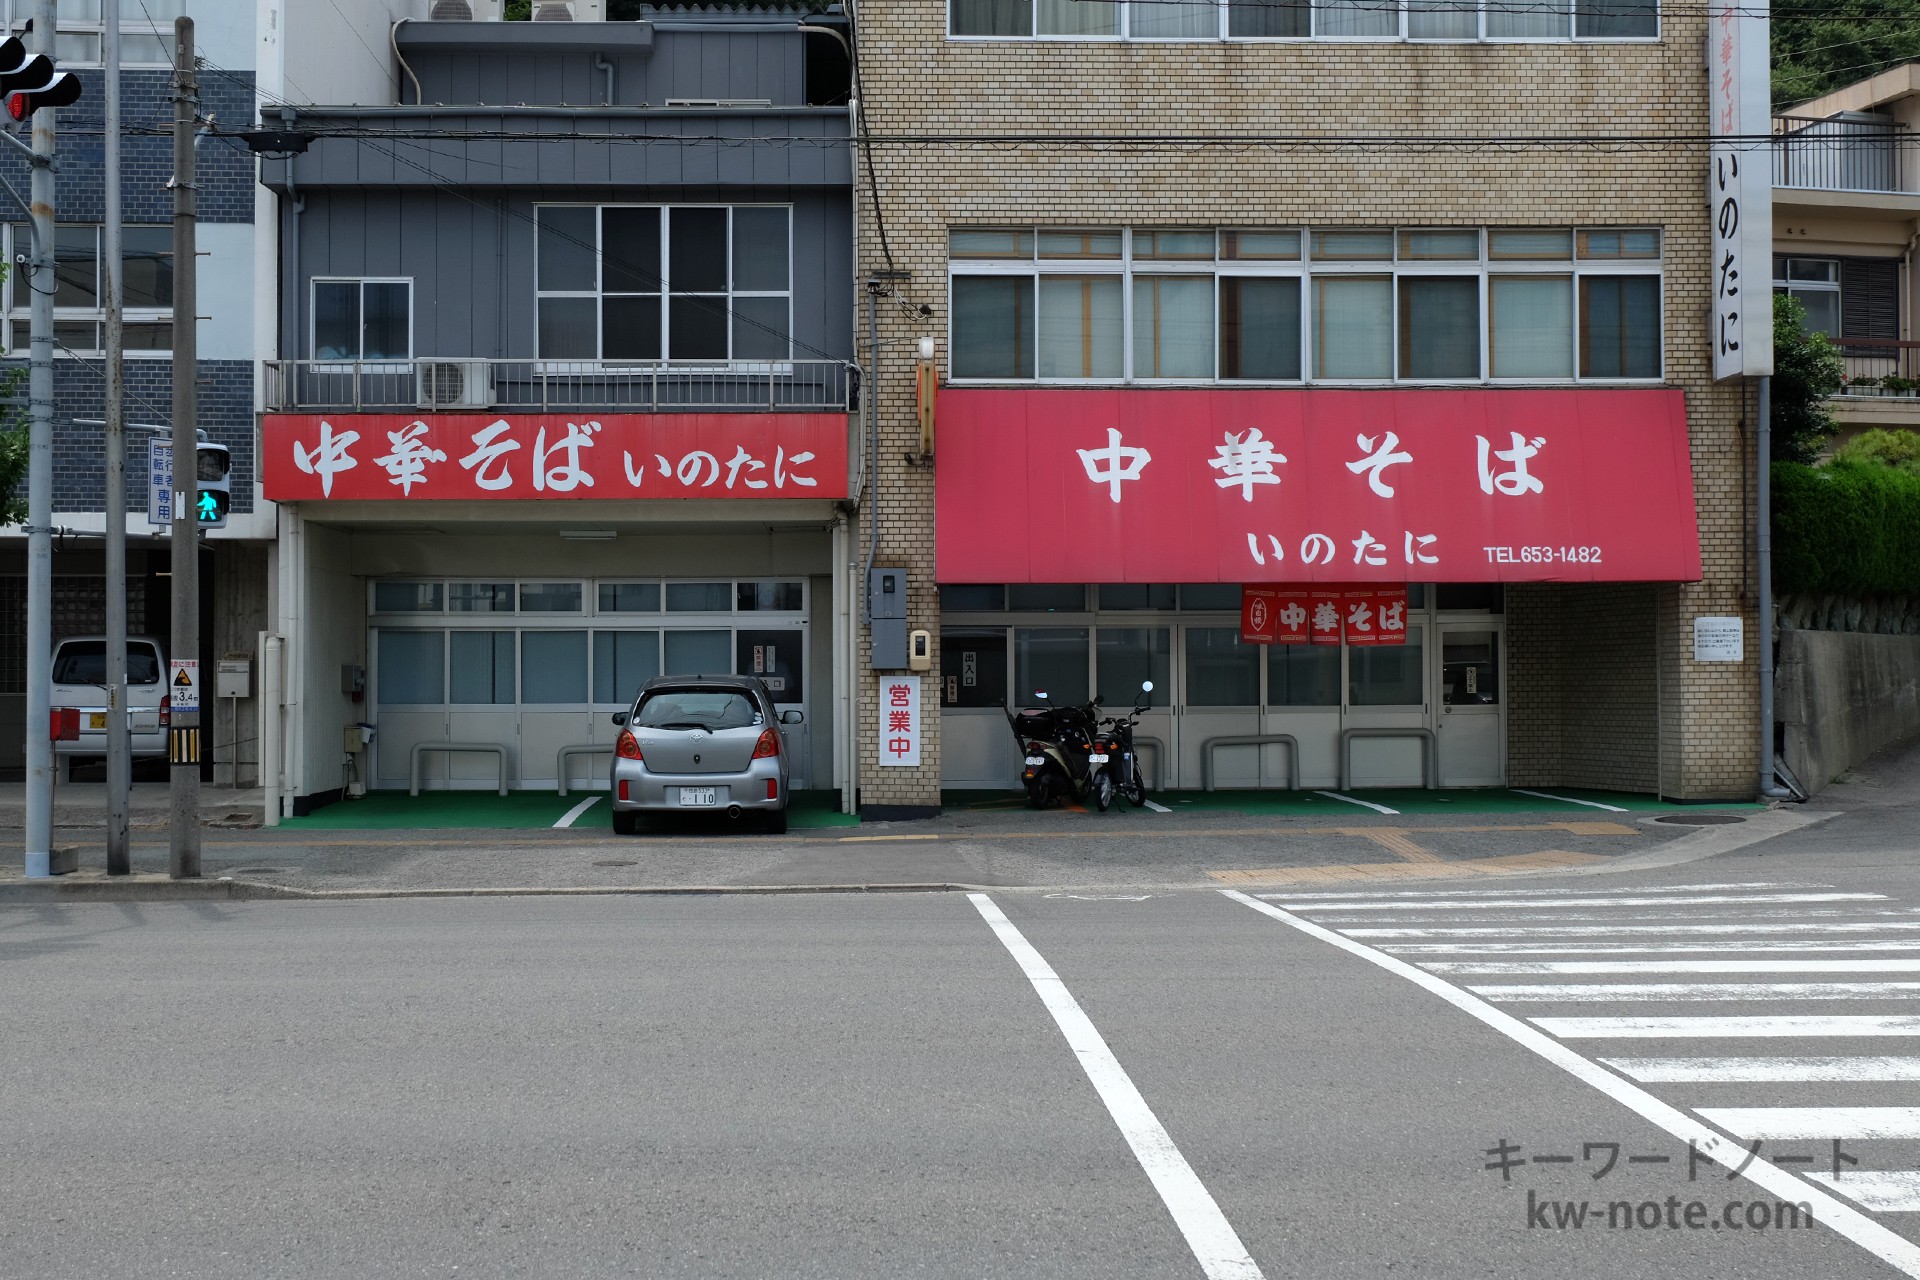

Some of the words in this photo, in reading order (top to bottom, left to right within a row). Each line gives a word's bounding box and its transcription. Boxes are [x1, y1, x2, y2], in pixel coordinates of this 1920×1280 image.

[1719, 2, 1735, 135] 中華そば
[1718, 153, 1739, 357] いのたに
[292, 417, 602, 499] 中華そば
[622, 444, 818, 490] いのたに
[1075, 427, 1547, 504] 中華そば
[1246, 529, 1440, 566] いのたに
[1280, 601, 1406, 633] 中華そば
[965, 653, 975, 685] 出入口
[889, 685, 911, 759] 営業中
